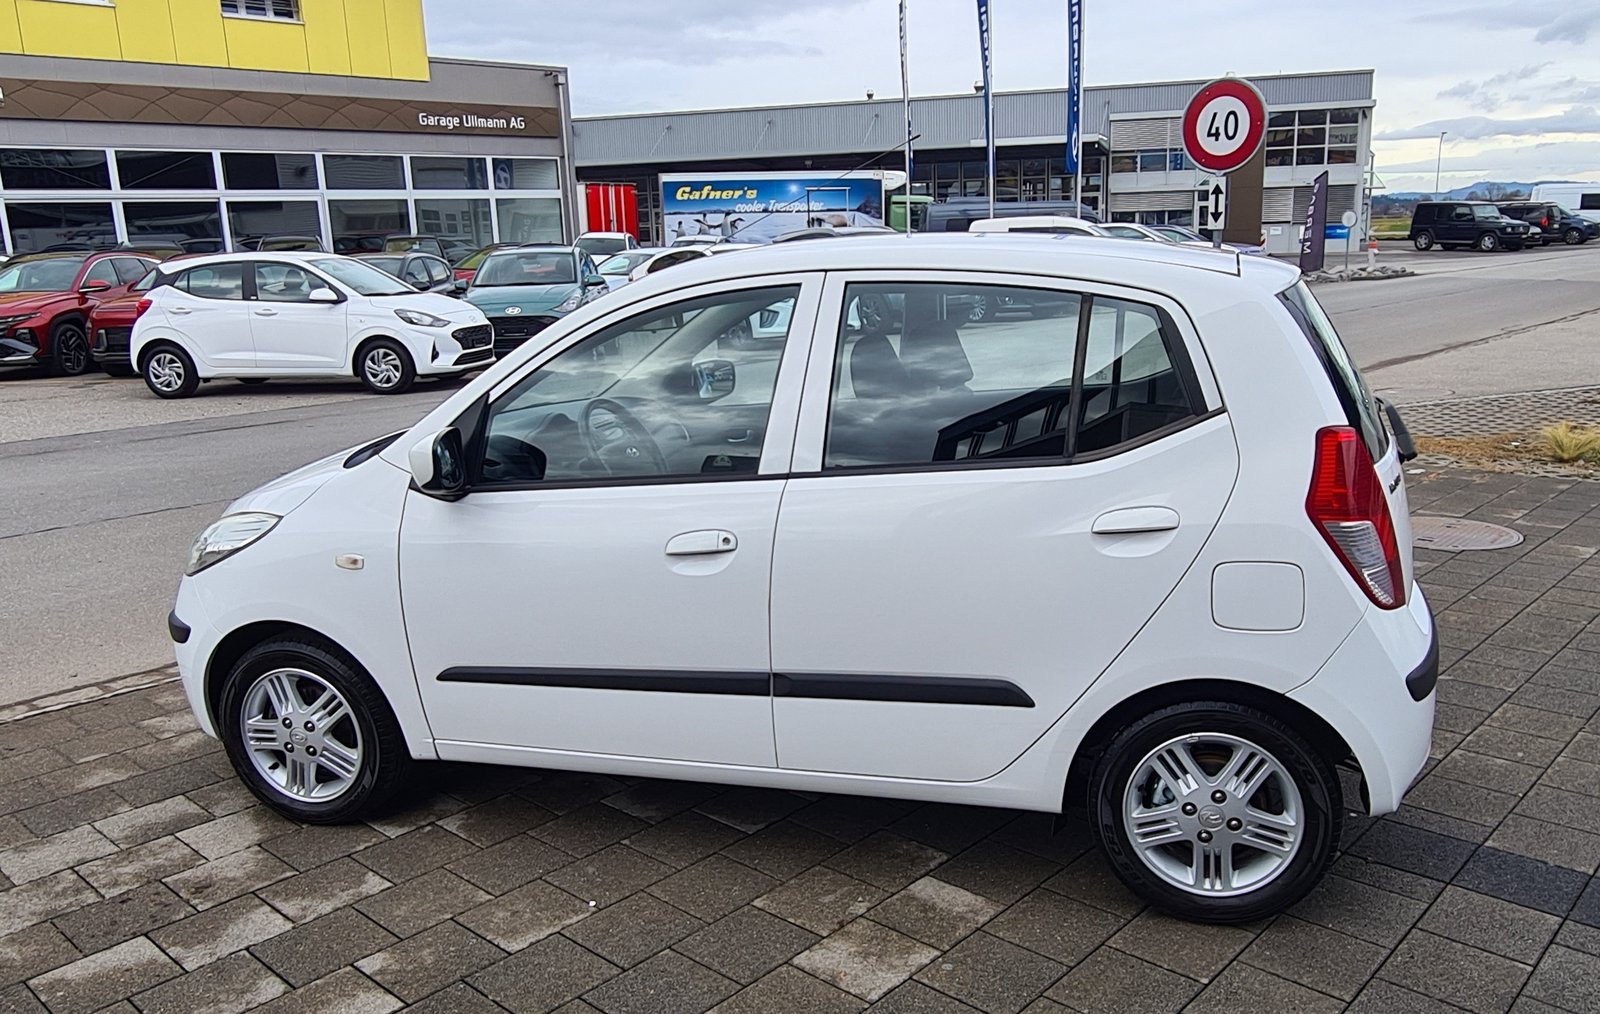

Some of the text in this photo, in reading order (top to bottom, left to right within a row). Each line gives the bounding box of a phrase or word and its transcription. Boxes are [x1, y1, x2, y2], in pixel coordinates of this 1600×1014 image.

[418, 112, 525, 129] Garage Ullmann AG
[1207, 110, 1239, 141] 40
[675, 185, 758, 201] Gafner's
[735, 200, 824, 213] cooler Transpoter
